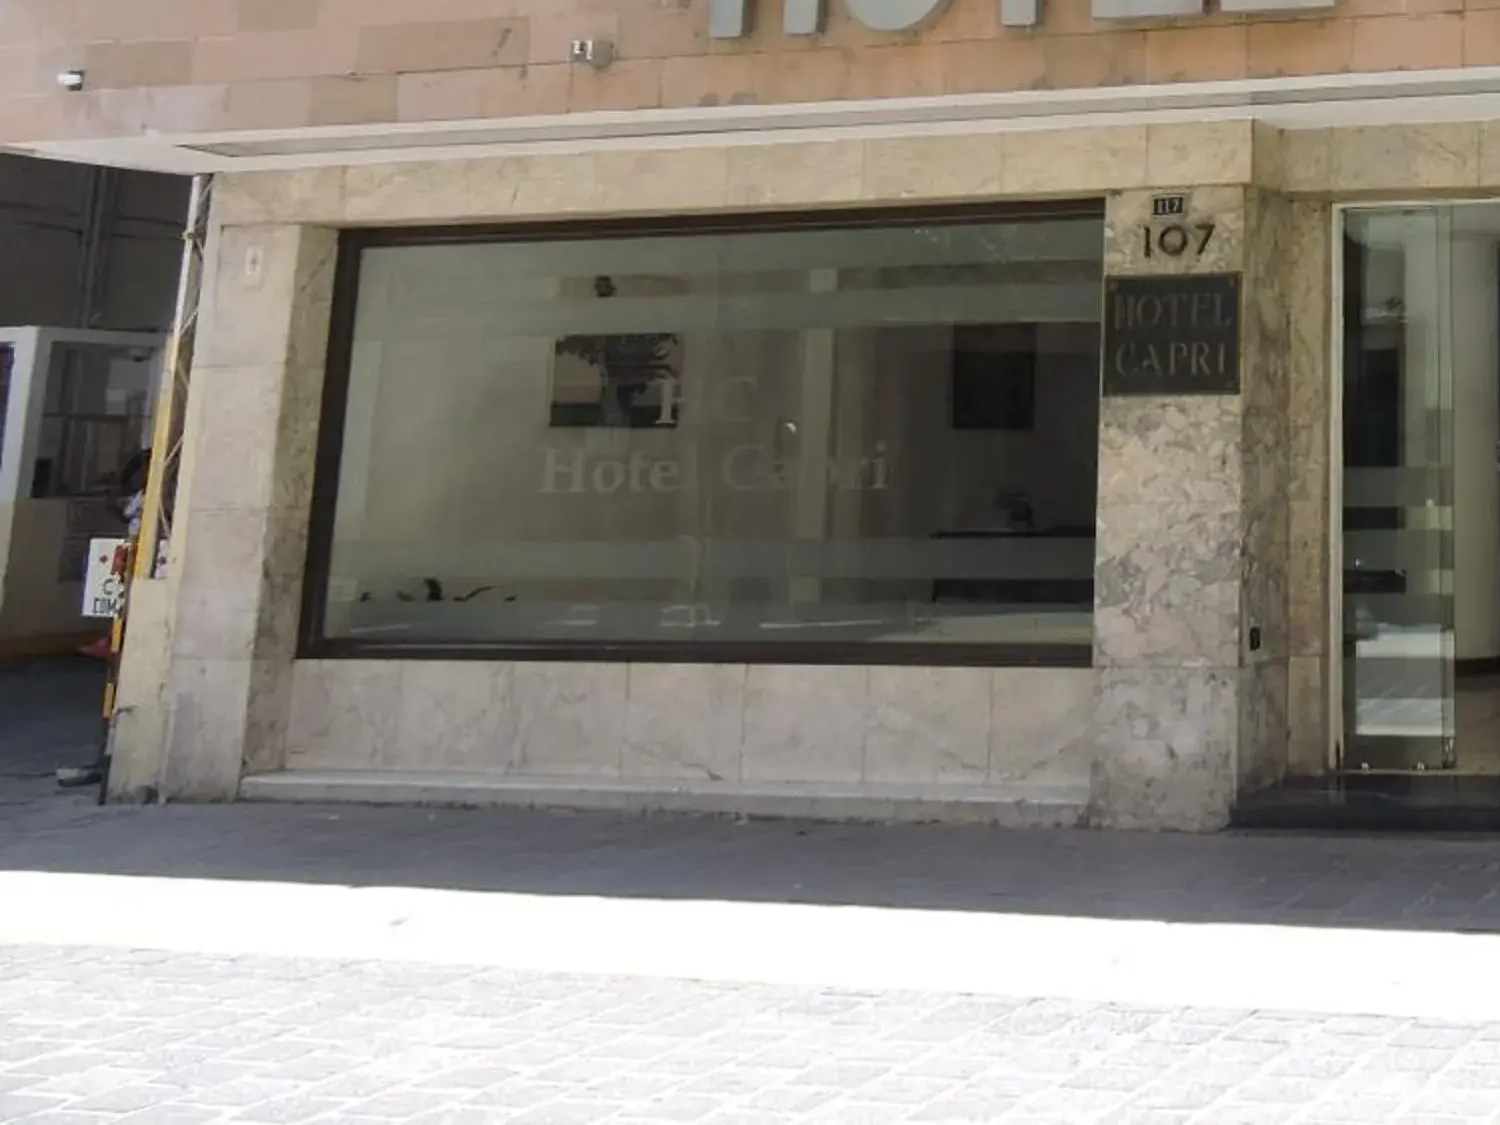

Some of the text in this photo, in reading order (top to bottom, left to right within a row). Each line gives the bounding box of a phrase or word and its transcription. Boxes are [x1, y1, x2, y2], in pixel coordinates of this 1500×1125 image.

[1142, 223, 1215, 258] 107
[1114, 293, 1234, 330] HOTEL
[1114, 341, 1227, 377] CAPRI
[719, 438, 891, 491] Cari
